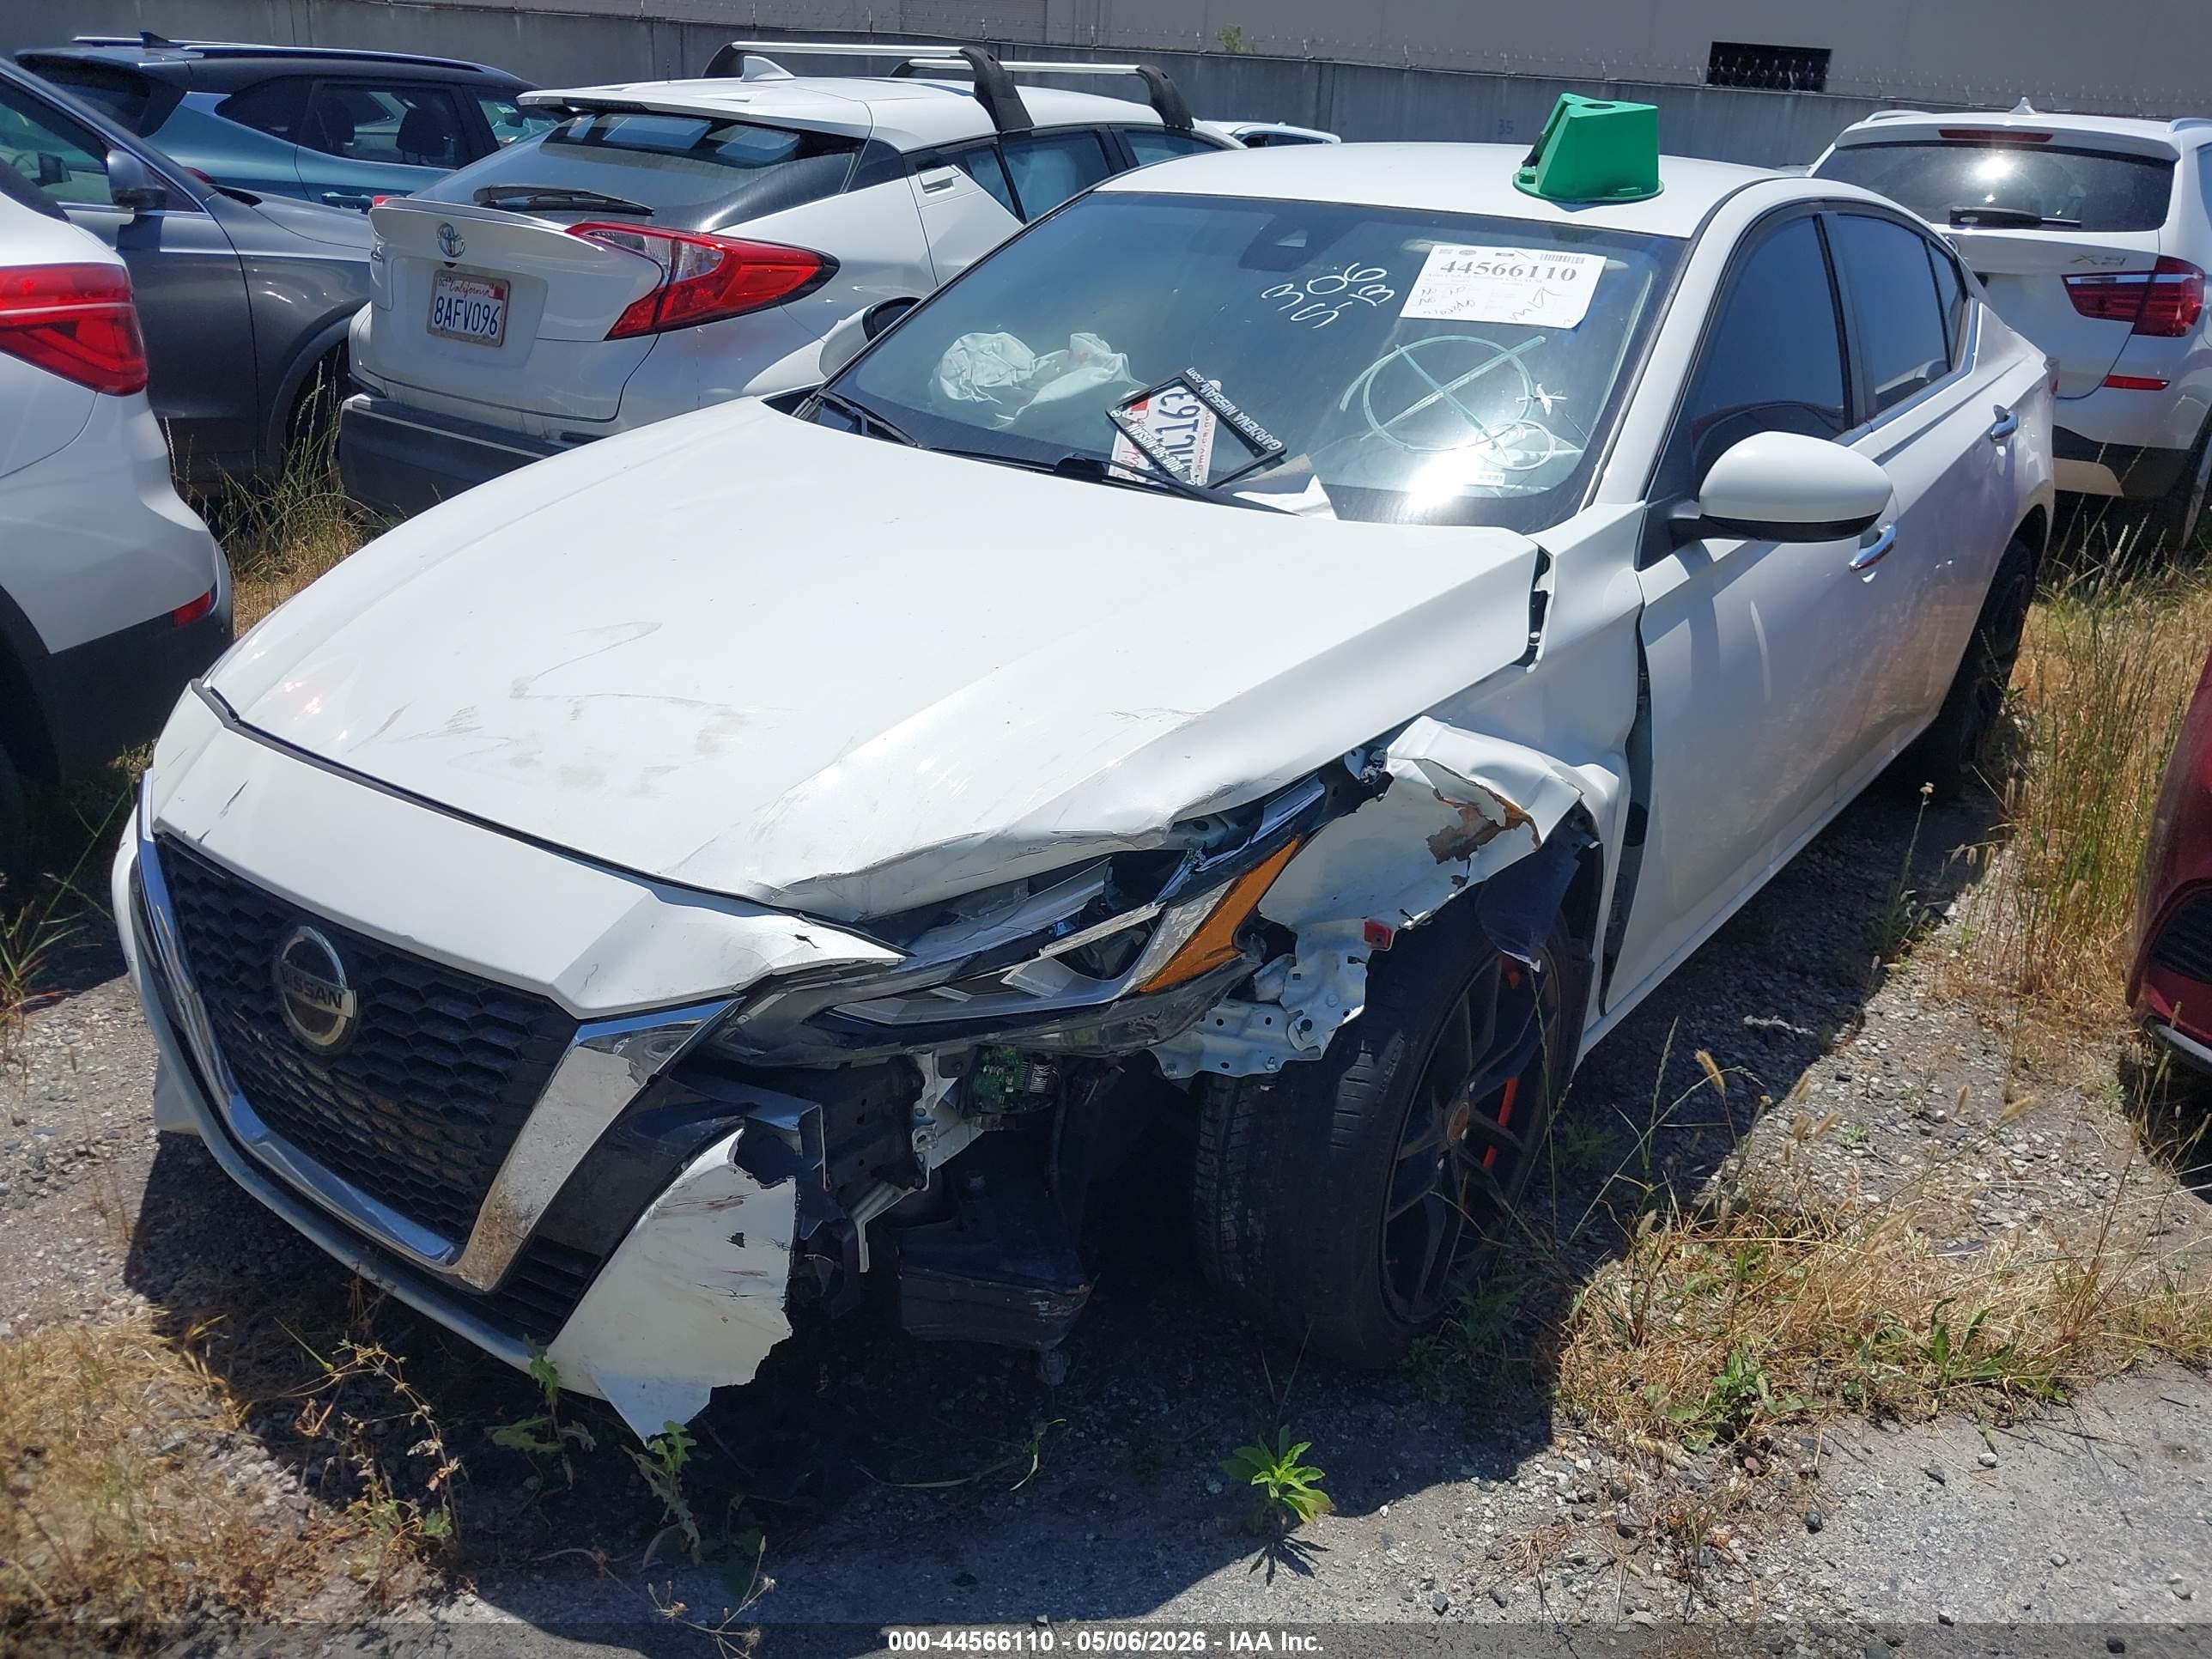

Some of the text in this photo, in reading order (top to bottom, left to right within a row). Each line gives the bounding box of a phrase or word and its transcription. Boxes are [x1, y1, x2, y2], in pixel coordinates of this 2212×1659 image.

[449, 279, 491, 298] California
[1261, 262, 1388, 312] 306
[1440, 260, 1577, 282] 44566110
[434, 295, 501, 336] 8AFV096
[1233, 411, 1283, 451] GARDENA
[282, 968, 343, 1010] NISSAN
